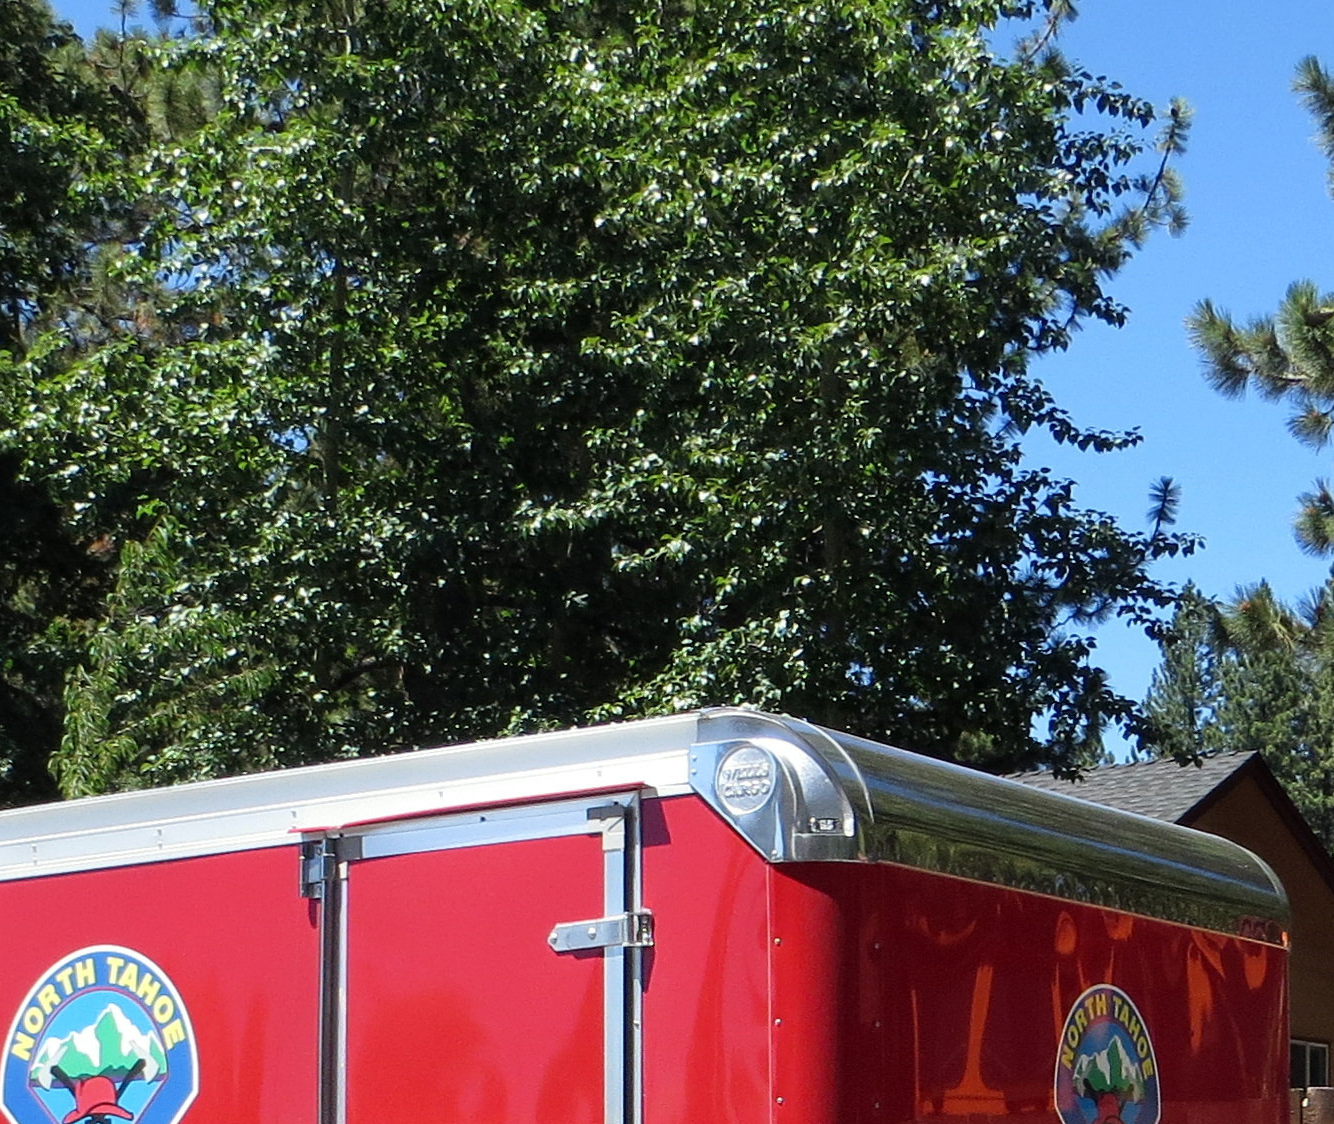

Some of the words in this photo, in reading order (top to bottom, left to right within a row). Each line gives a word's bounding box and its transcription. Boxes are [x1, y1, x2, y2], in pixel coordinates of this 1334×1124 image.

[10, 957, 96, 1061] NORTH
[106, 956, 186, 1051] TAHOE
[1060, 993, 1107, 1071] NORTH
[1112, 995, 1155, 1081] TAHOE
